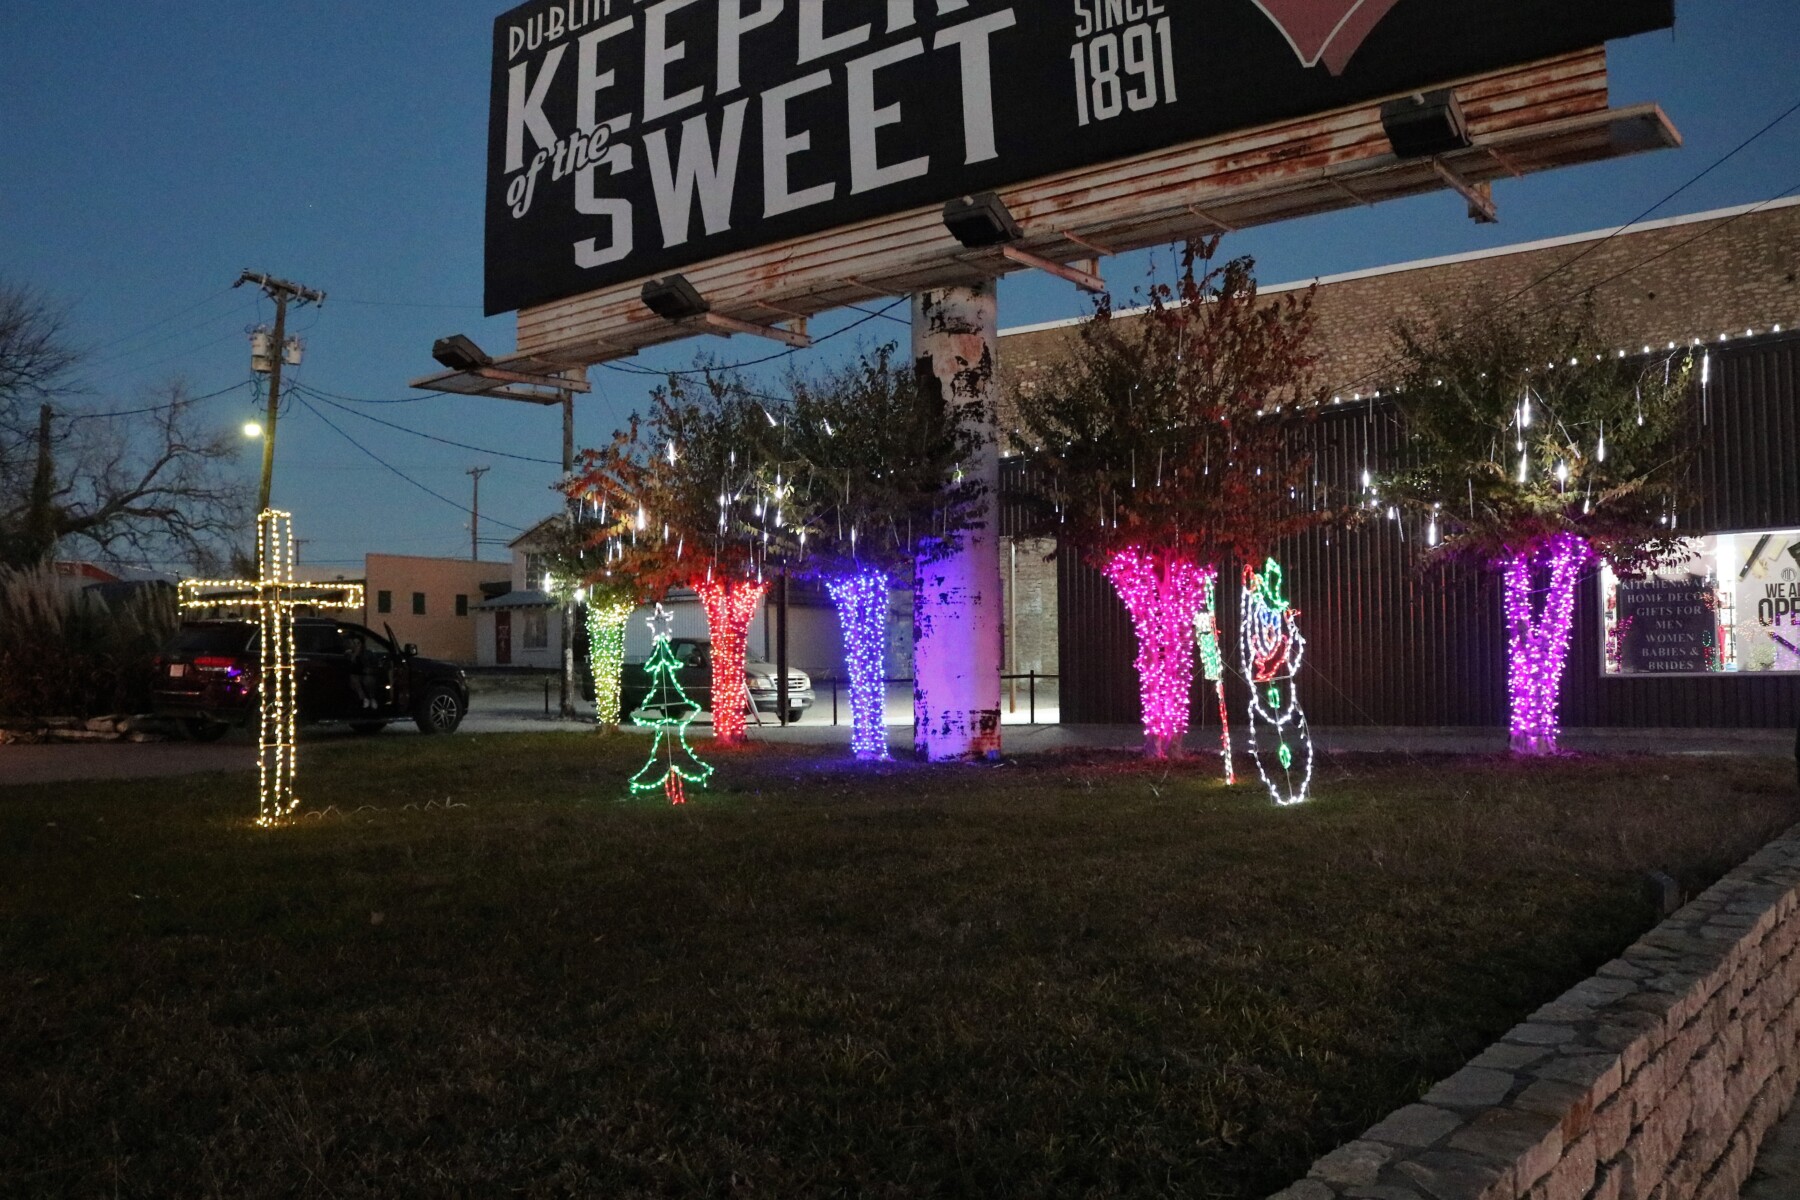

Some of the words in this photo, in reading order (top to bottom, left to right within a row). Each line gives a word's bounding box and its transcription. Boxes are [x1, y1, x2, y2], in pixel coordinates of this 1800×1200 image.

[1070, 16, 1177, 127] 1891
[504, 0, 969, 174] KEEP
[573, 8, 1016, 269] SWEET
[506, 150, 548, 219] of
[551, 127, 610, 182] the
[1765, 583, 1786, 598] WE
[1627, 593, 1664, 603] HOME
[1667, 592, 1703, 602] DECO
[1636, 607, 1673, 616] GIFTS
[1676, 605, 1702, 615] FOR
[1758, 597, 1800, 627] OPE
[1656, 620, 1684, 630] MEN
[1645, 633, 1695, 643] WOMEN
[1642, 647, 1687, 657] BABIES
[1689, 646, 1700, 656] &
[1648, 660, 1694, 670] BRIDES
